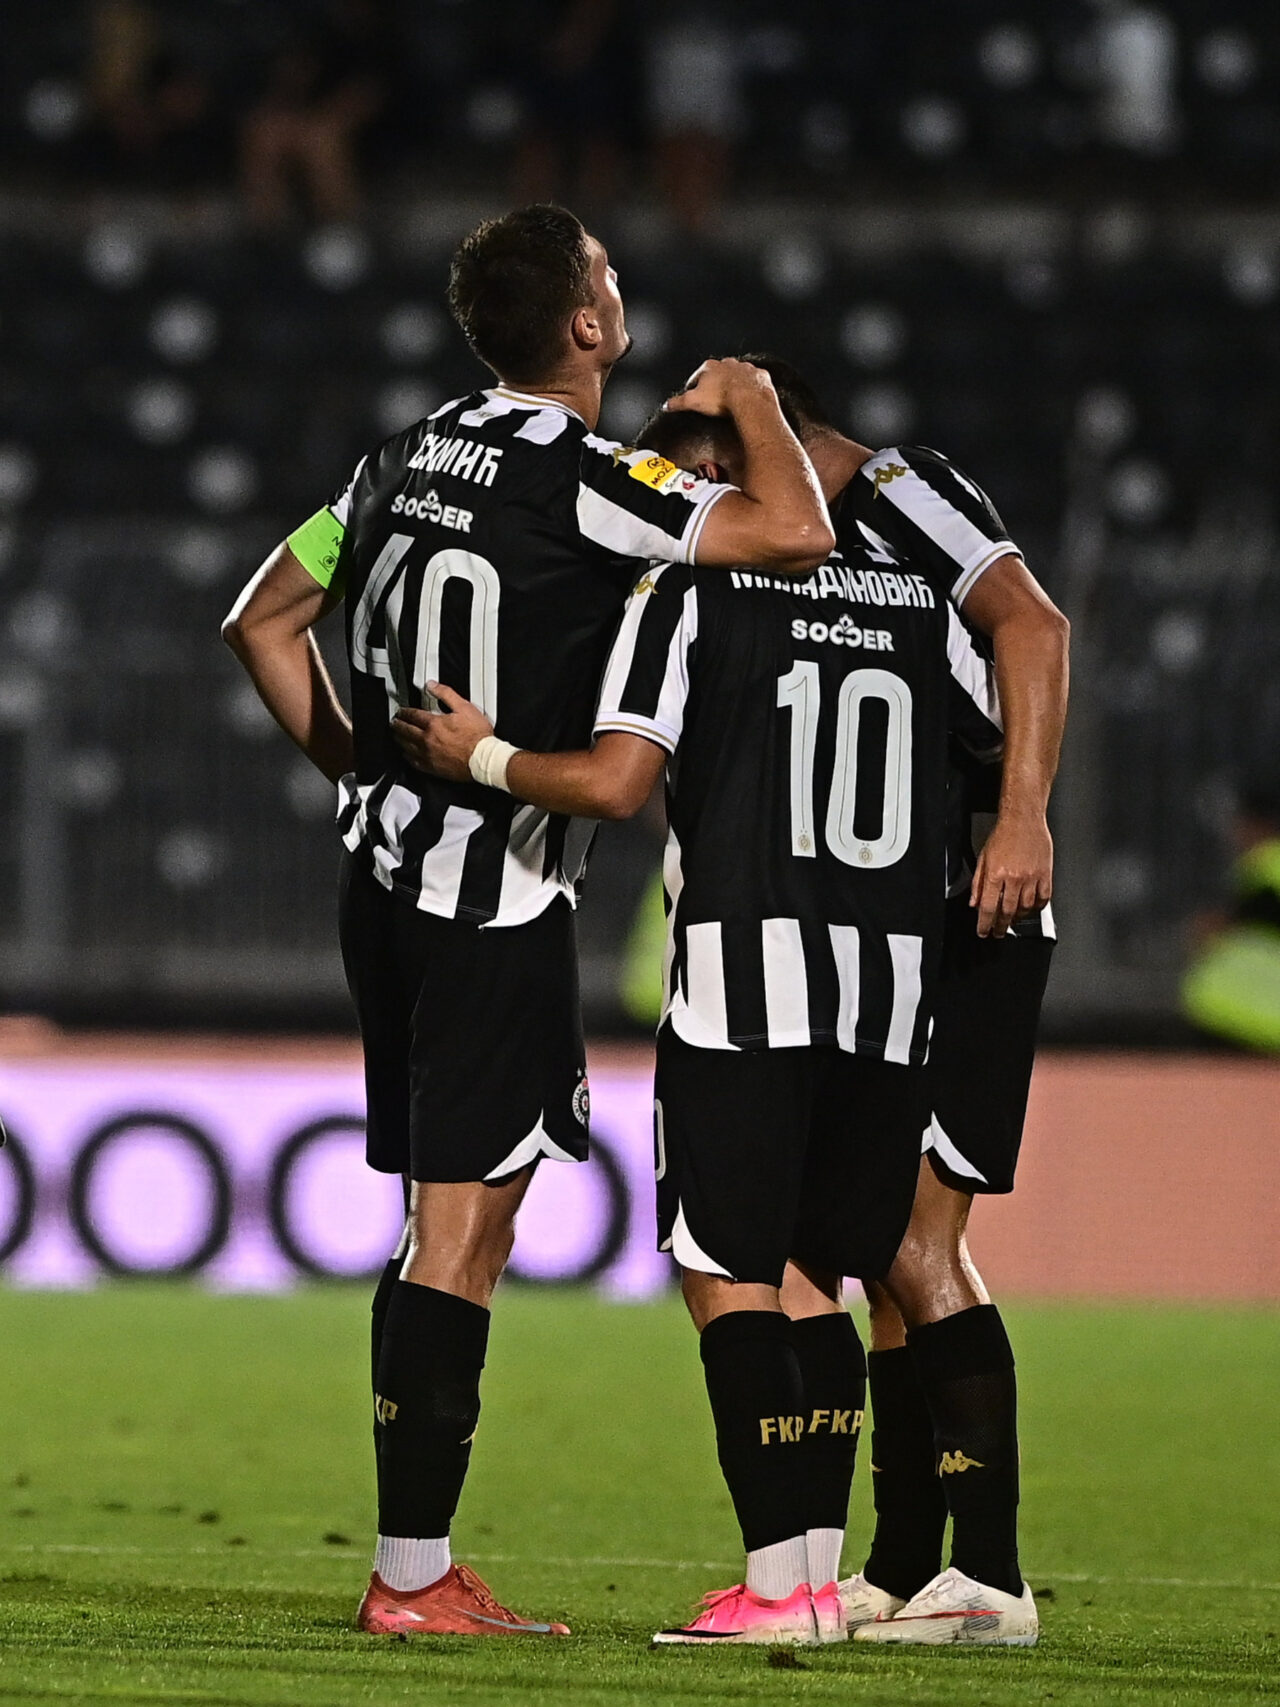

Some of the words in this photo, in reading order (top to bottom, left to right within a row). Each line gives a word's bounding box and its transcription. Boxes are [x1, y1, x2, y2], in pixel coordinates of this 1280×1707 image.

[391, 489, 473, 533] SOCCER
[351, 532, 500, 728] 40
[791, 613, 895, 651] SOCCER
[777, 660, 912, 868] 10
[760, 1416, 804, 1445] FKP
[808, 1409, 864, 1434] FKP
